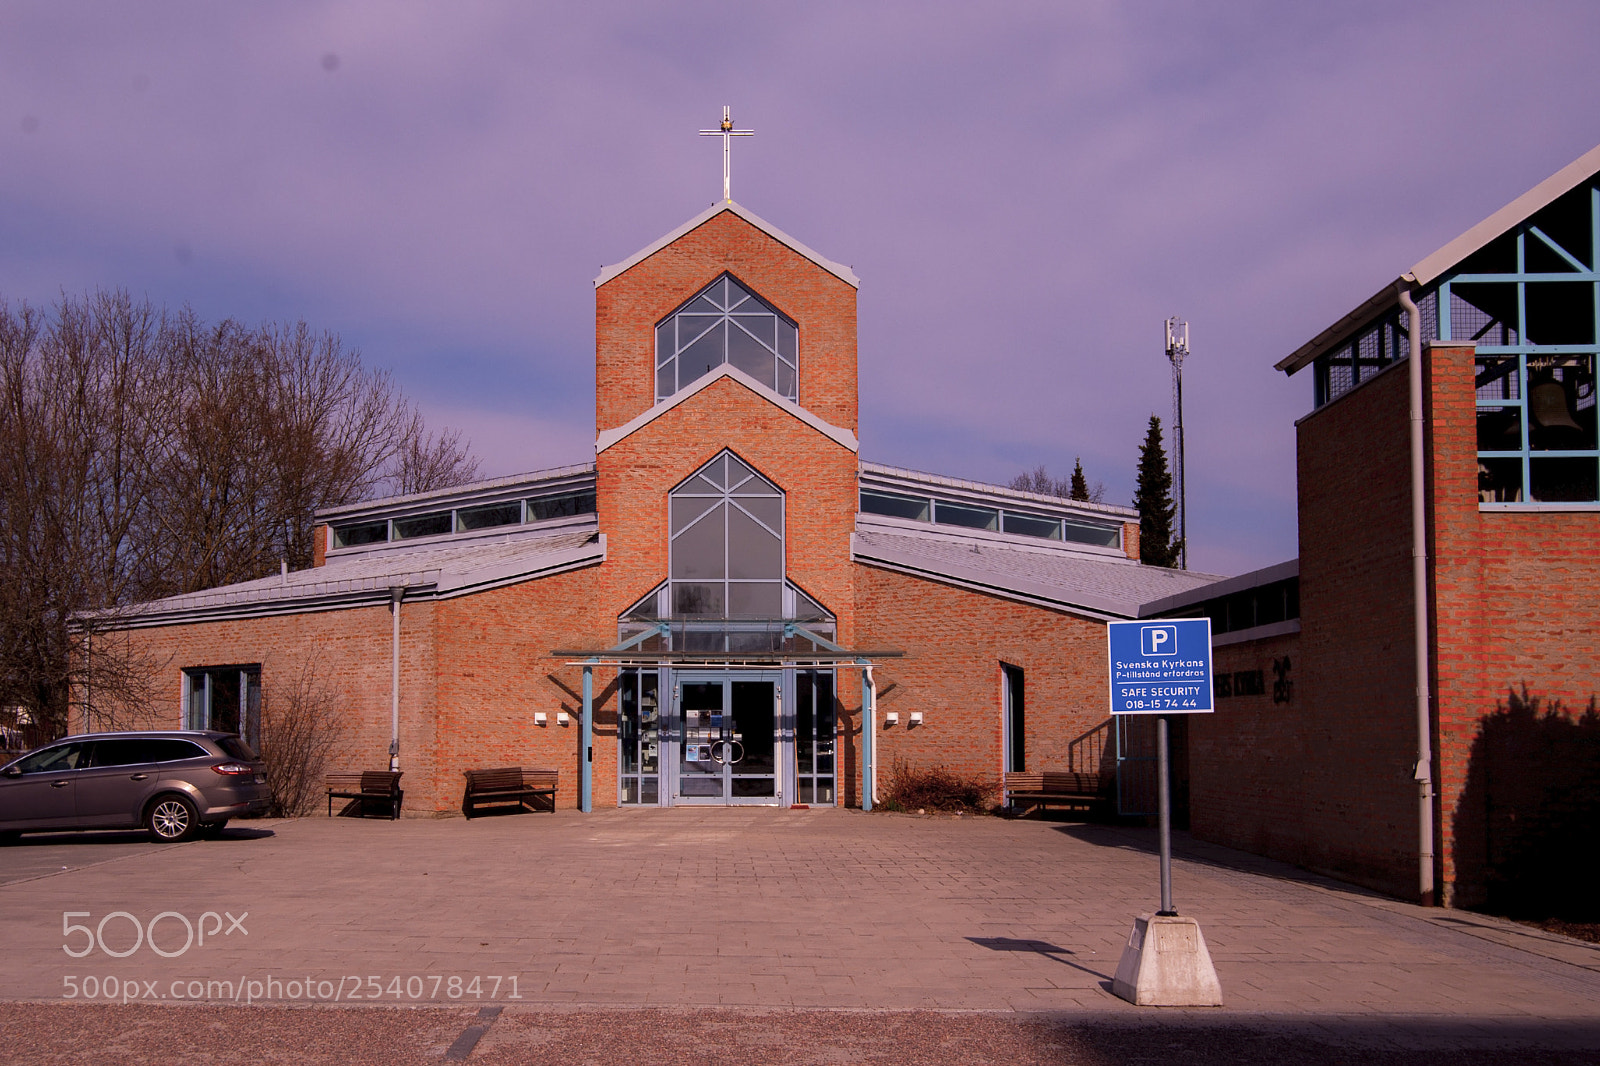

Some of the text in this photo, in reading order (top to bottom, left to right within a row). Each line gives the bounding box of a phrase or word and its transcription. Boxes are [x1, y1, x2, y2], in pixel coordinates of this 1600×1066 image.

[1151, 629, 1169, 652] P
[1116, 660, 1204, 670] Svenska Kyrkans
[1116, 670, 1205, 679] P-tillstånd erfordras
[1121, 686, 1200, 697] SAFE SECURITY
[1125, 699, 1197, 709] 018-15 74 44
